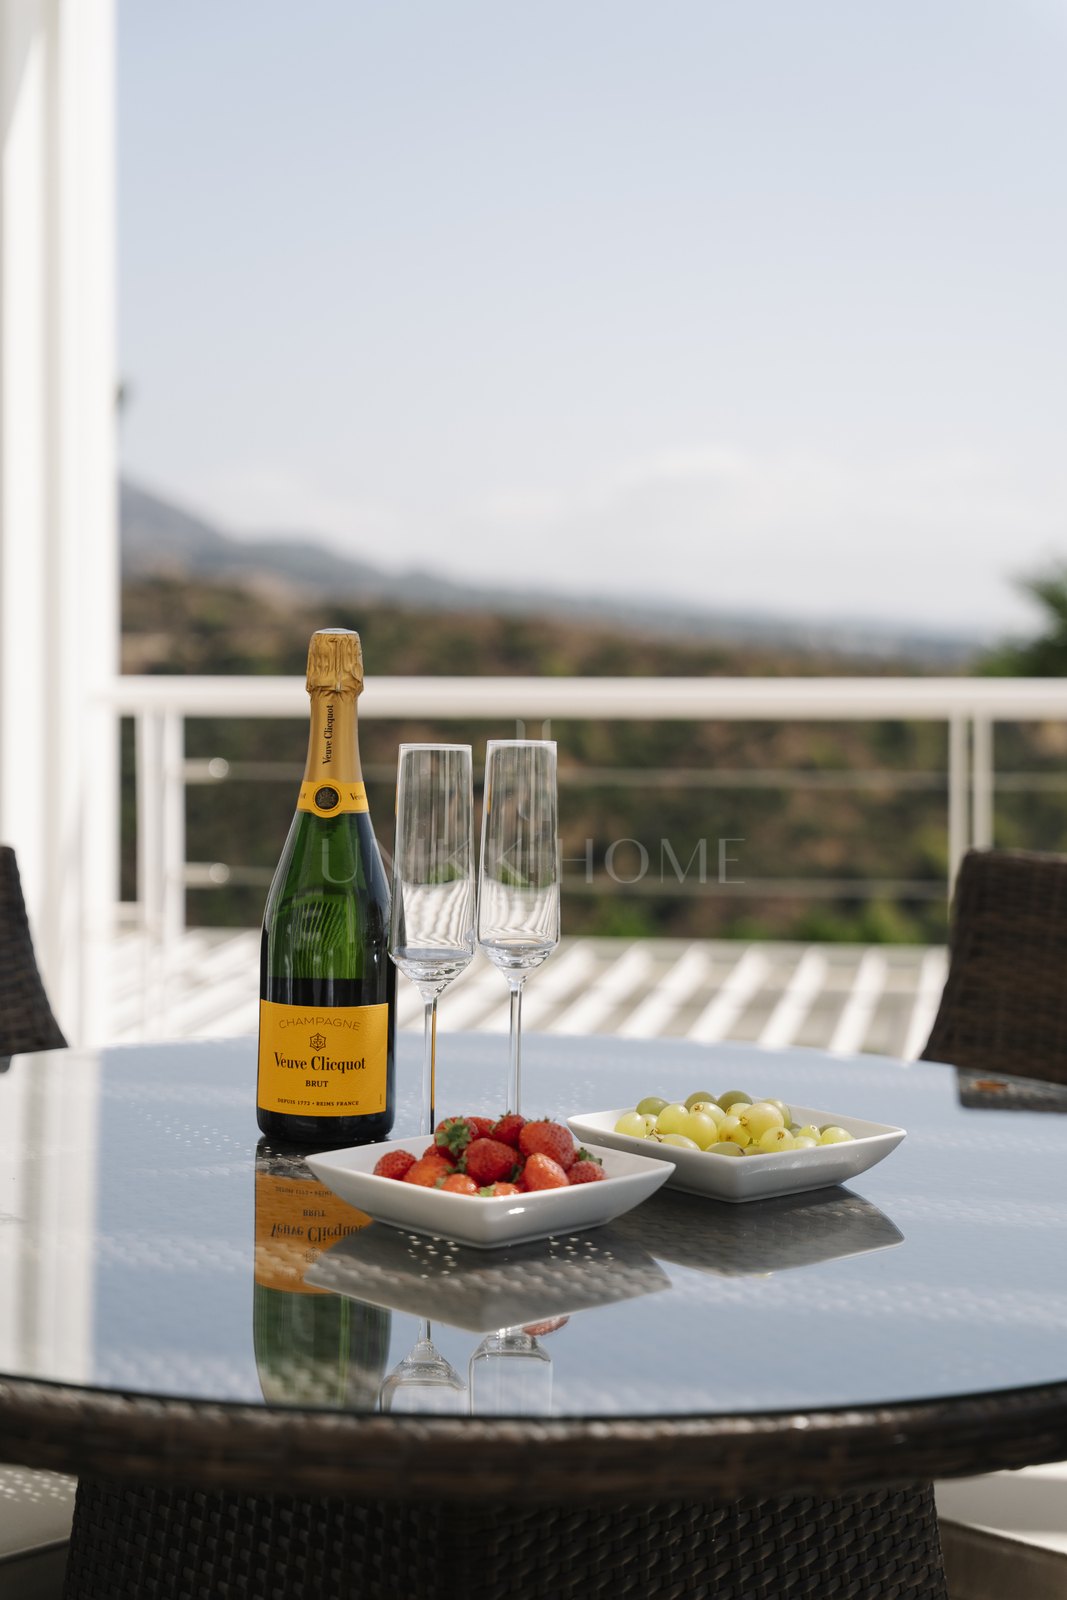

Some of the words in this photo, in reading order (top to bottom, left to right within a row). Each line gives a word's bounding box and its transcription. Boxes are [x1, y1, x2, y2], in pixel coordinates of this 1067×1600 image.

[324, 704, 335, 739] Clicquot
[322, 741, 333, 765] Veuve
[279, 1016, 361, 1031] CHAMPAGNE
[274, 1051, 308, 1070] Veuve
[310, 1055, 366, 1074] Clicquot
[305, 1080, 329, 1088] BRUT
[277, 1097, 296, 1105] DEPUIS
